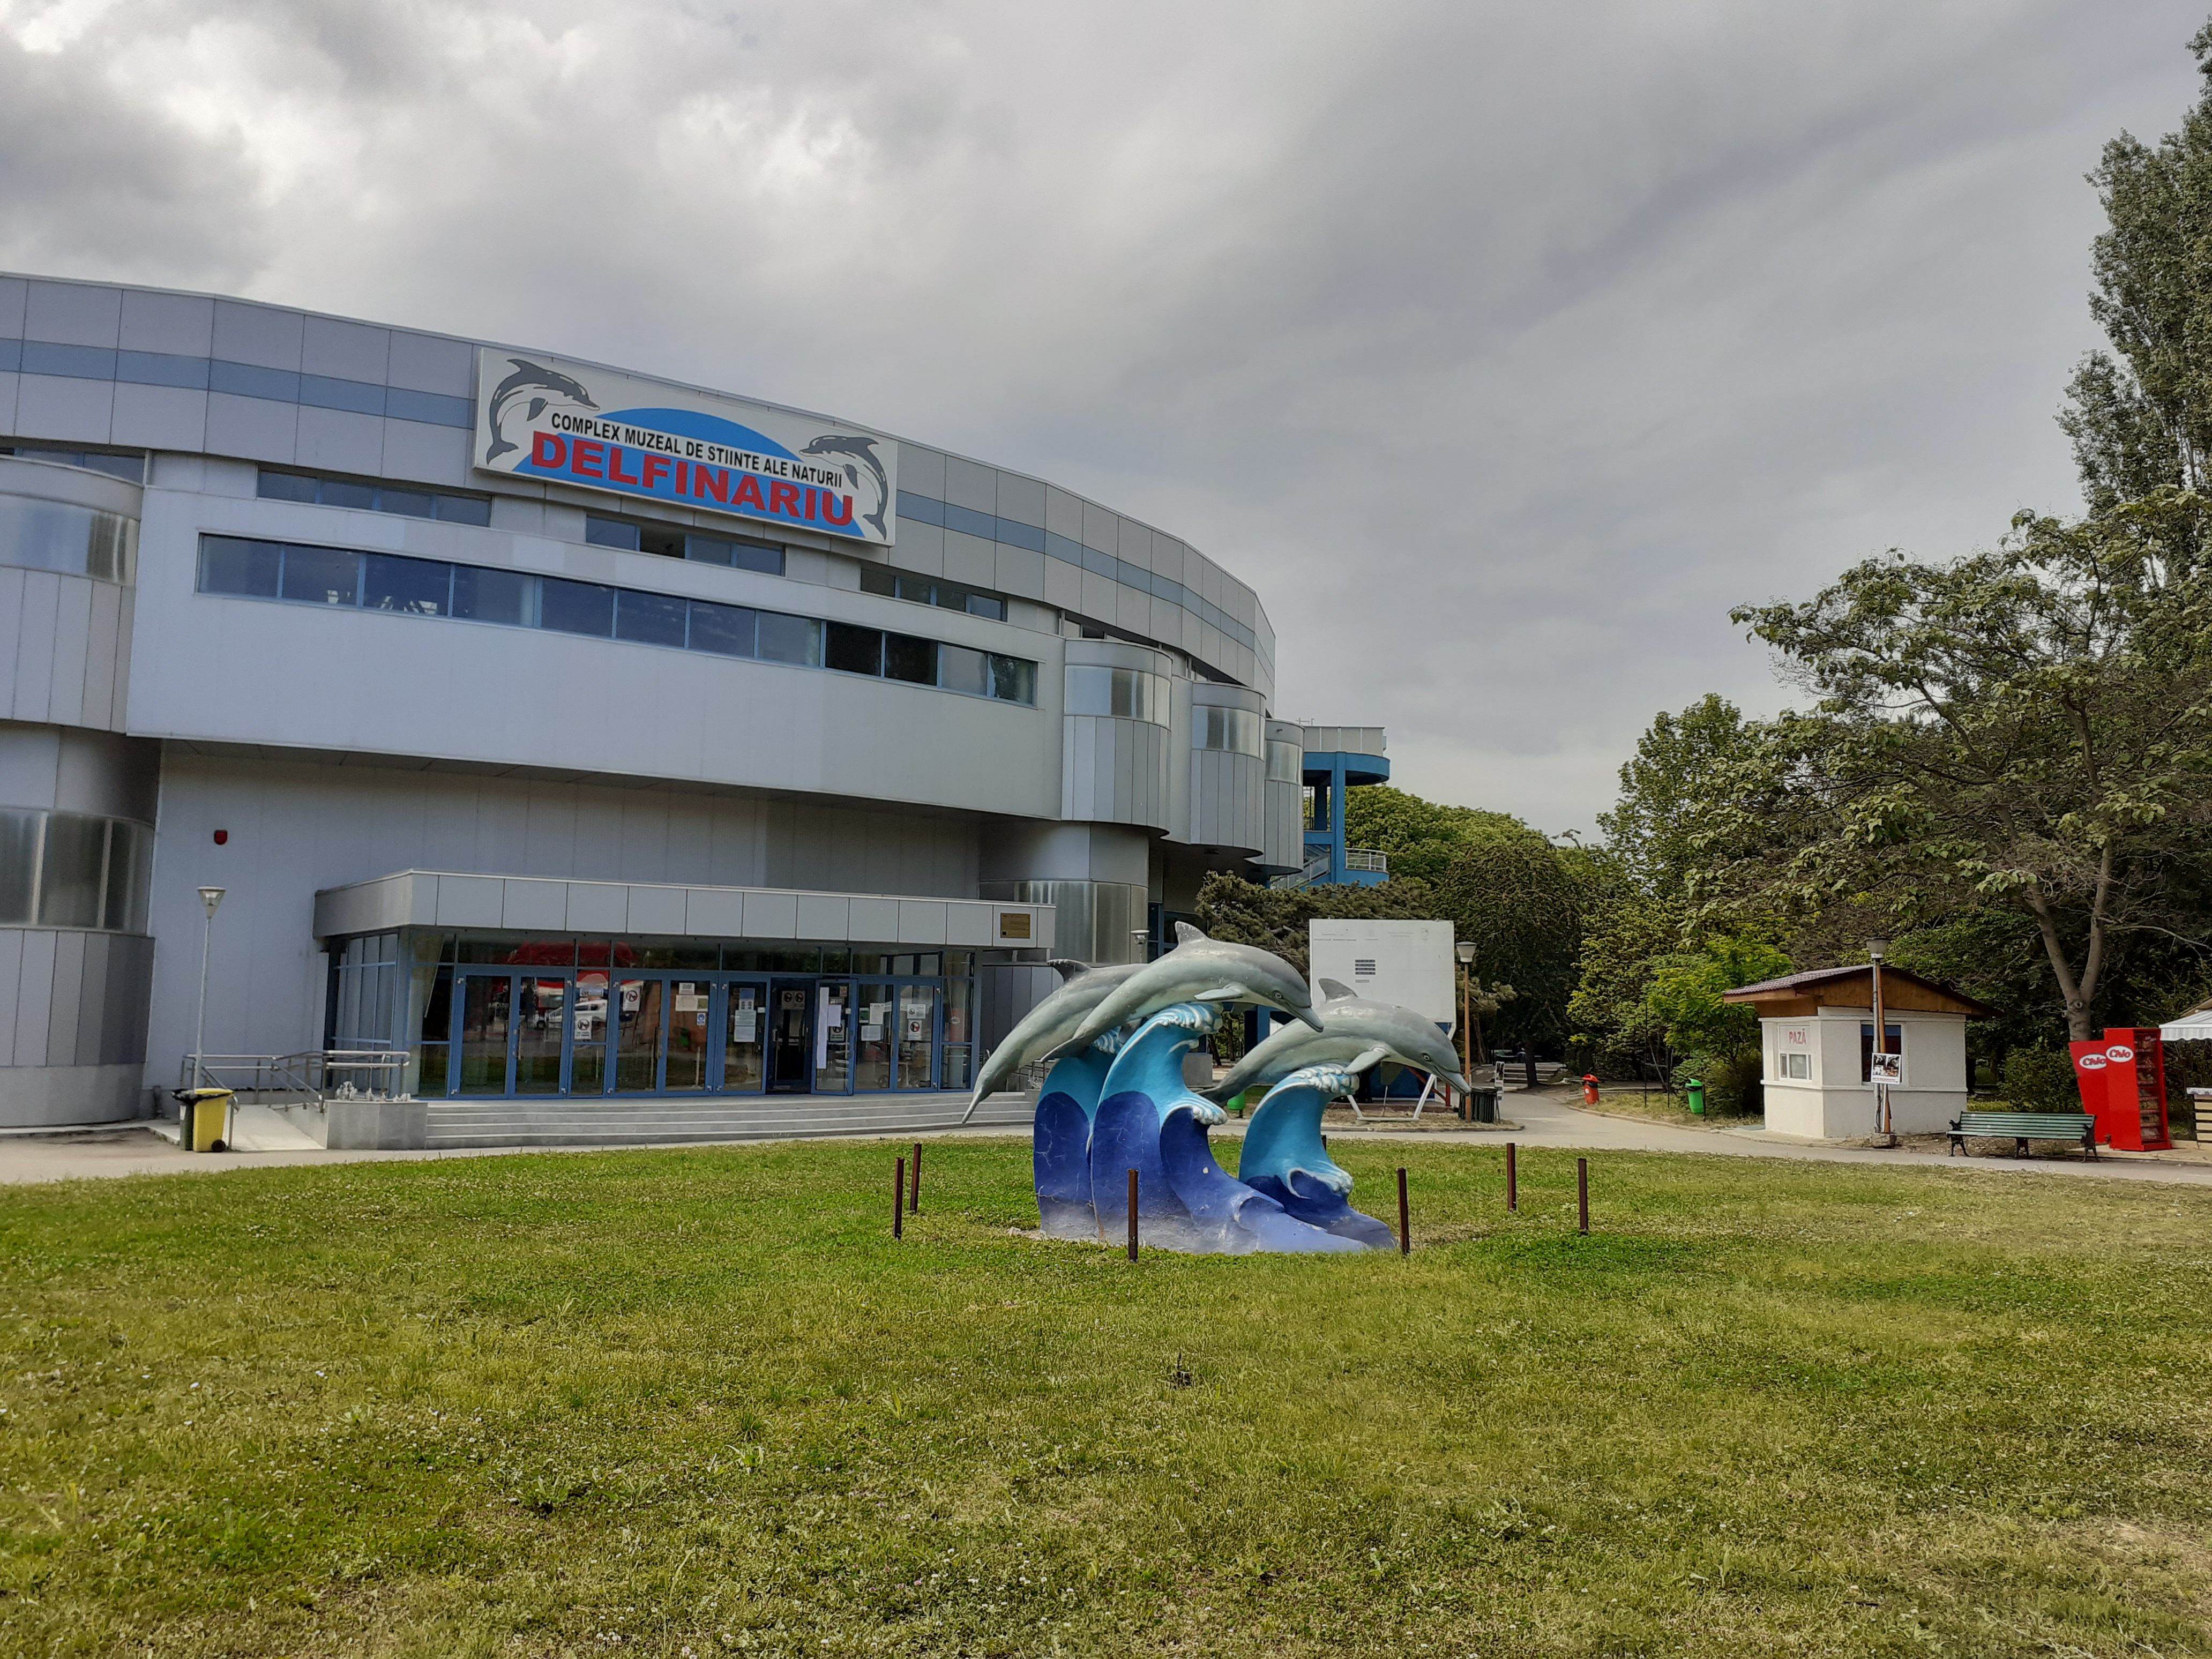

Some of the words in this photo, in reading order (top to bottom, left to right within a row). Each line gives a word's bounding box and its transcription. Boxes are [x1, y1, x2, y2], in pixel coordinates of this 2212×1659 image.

[551, 413, 620, 442] COMPLEX
[625, 428, 682, 454] MUZEAL
[686, 441, 703, 459] DE
[707, 446, 759, 470] STIINTE
[763, 458, 788, 476] ALE
[792, 464, 842, 488] NATURII
[532, 430, 853, 526] DELFINARIU
[2082, 1057, 2106, 1066] Chio
[2109, 1049, 2131, 1058] Chio
